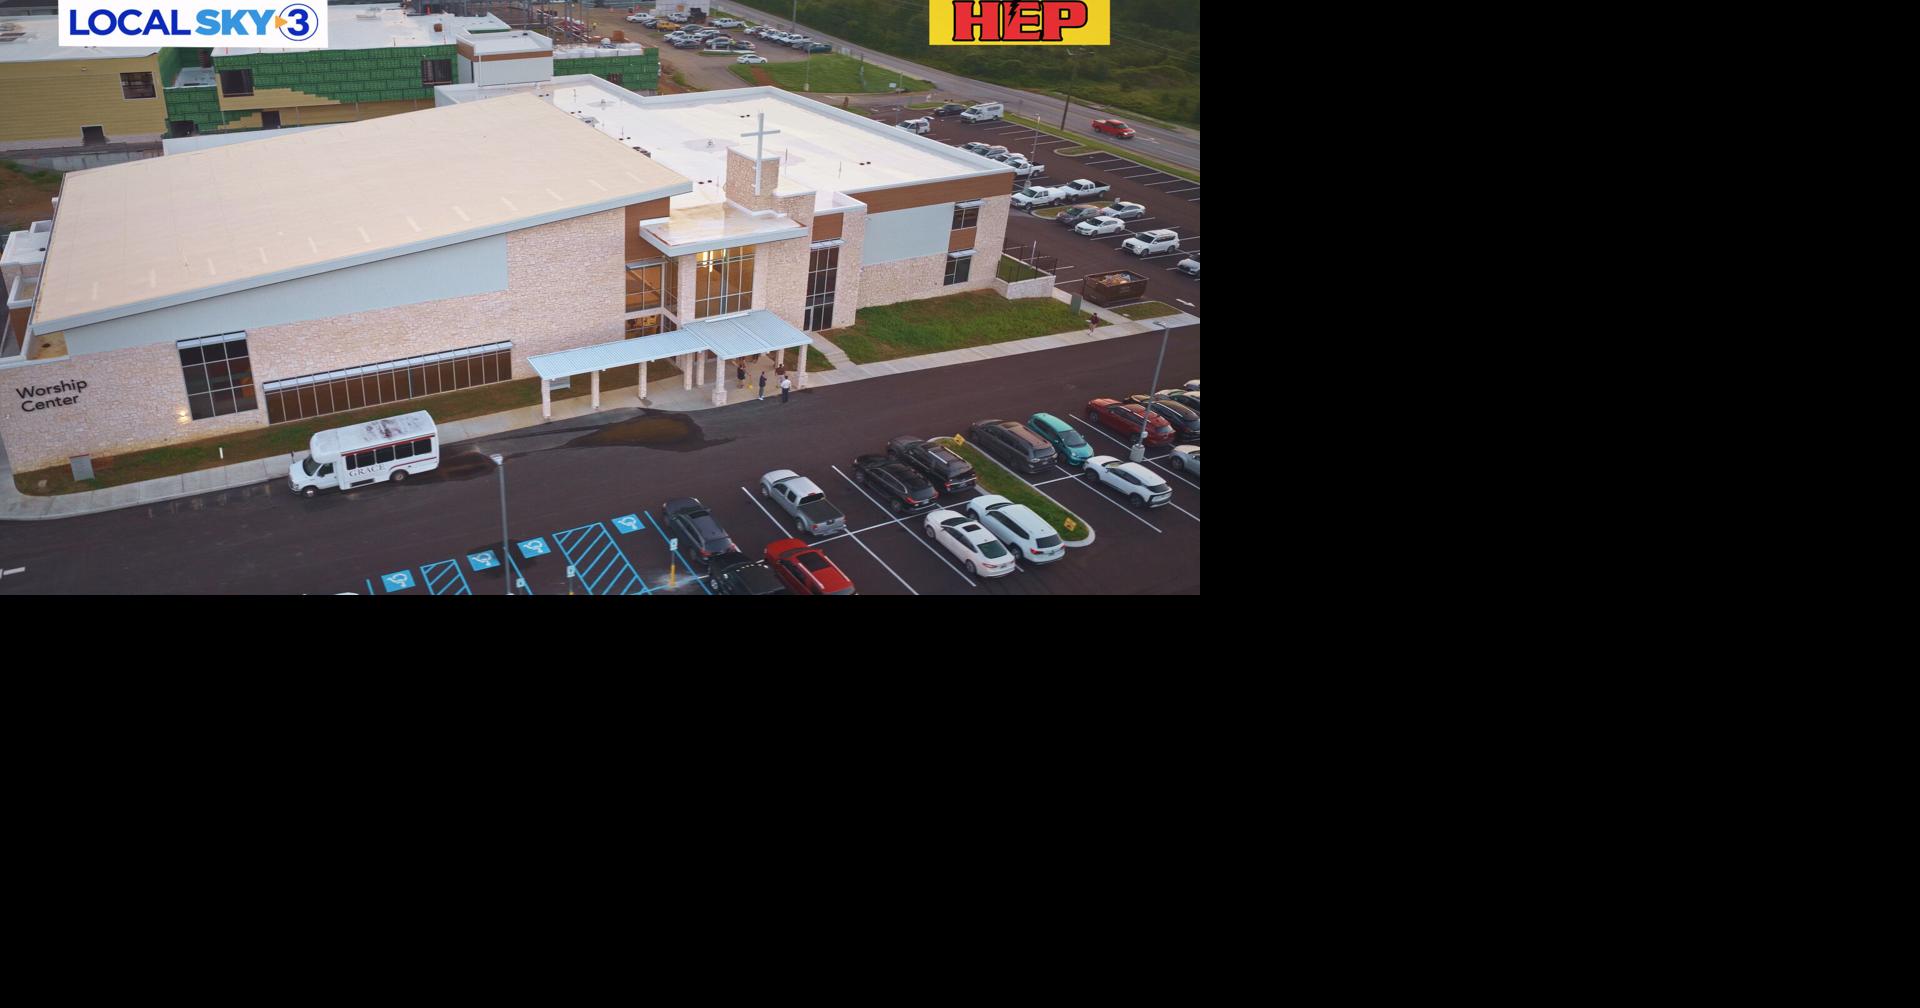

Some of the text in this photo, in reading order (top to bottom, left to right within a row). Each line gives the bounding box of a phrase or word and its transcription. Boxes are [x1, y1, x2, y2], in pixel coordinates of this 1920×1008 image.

[15, 379, 88, 399] Worship
[21, 395, 79, 412] Center
[348, 464, 386, 478] GRACE
